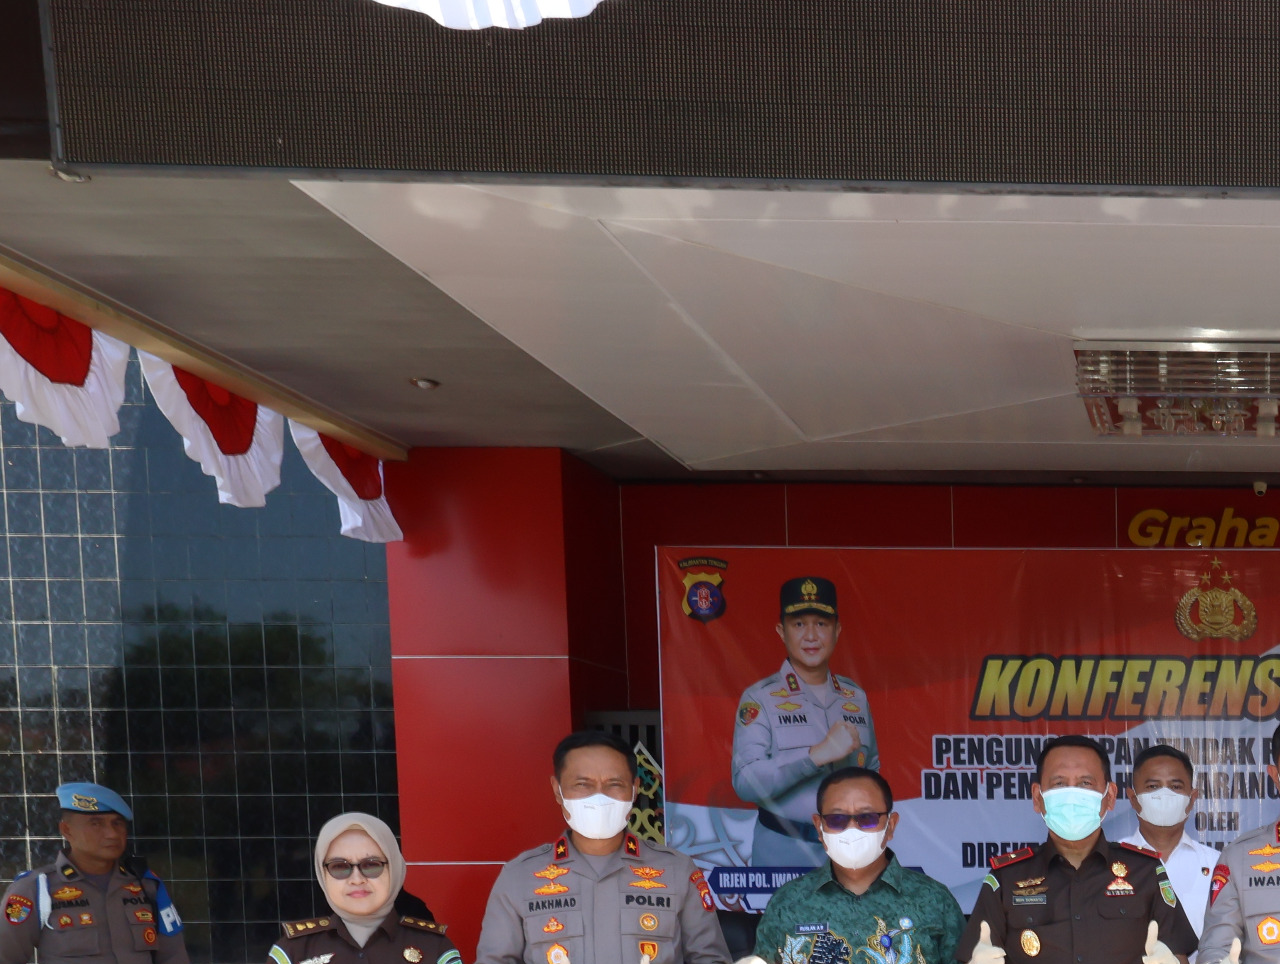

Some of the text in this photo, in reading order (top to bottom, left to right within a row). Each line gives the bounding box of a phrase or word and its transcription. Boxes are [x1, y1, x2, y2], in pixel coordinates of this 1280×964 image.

[1127, 508, 1280, 547] Graha
[778, 714, 808, 725] IWAN
[924, 772, 979, 800] DAN
[1195, 811, 1239, 832] OLEH
[719, 873, 746, 888] IRJEN
[749, 873, 770, 888] POL.
[528, 897, 576, 912] RAKHMAD
[625, 894, 671, 908] POLRI
